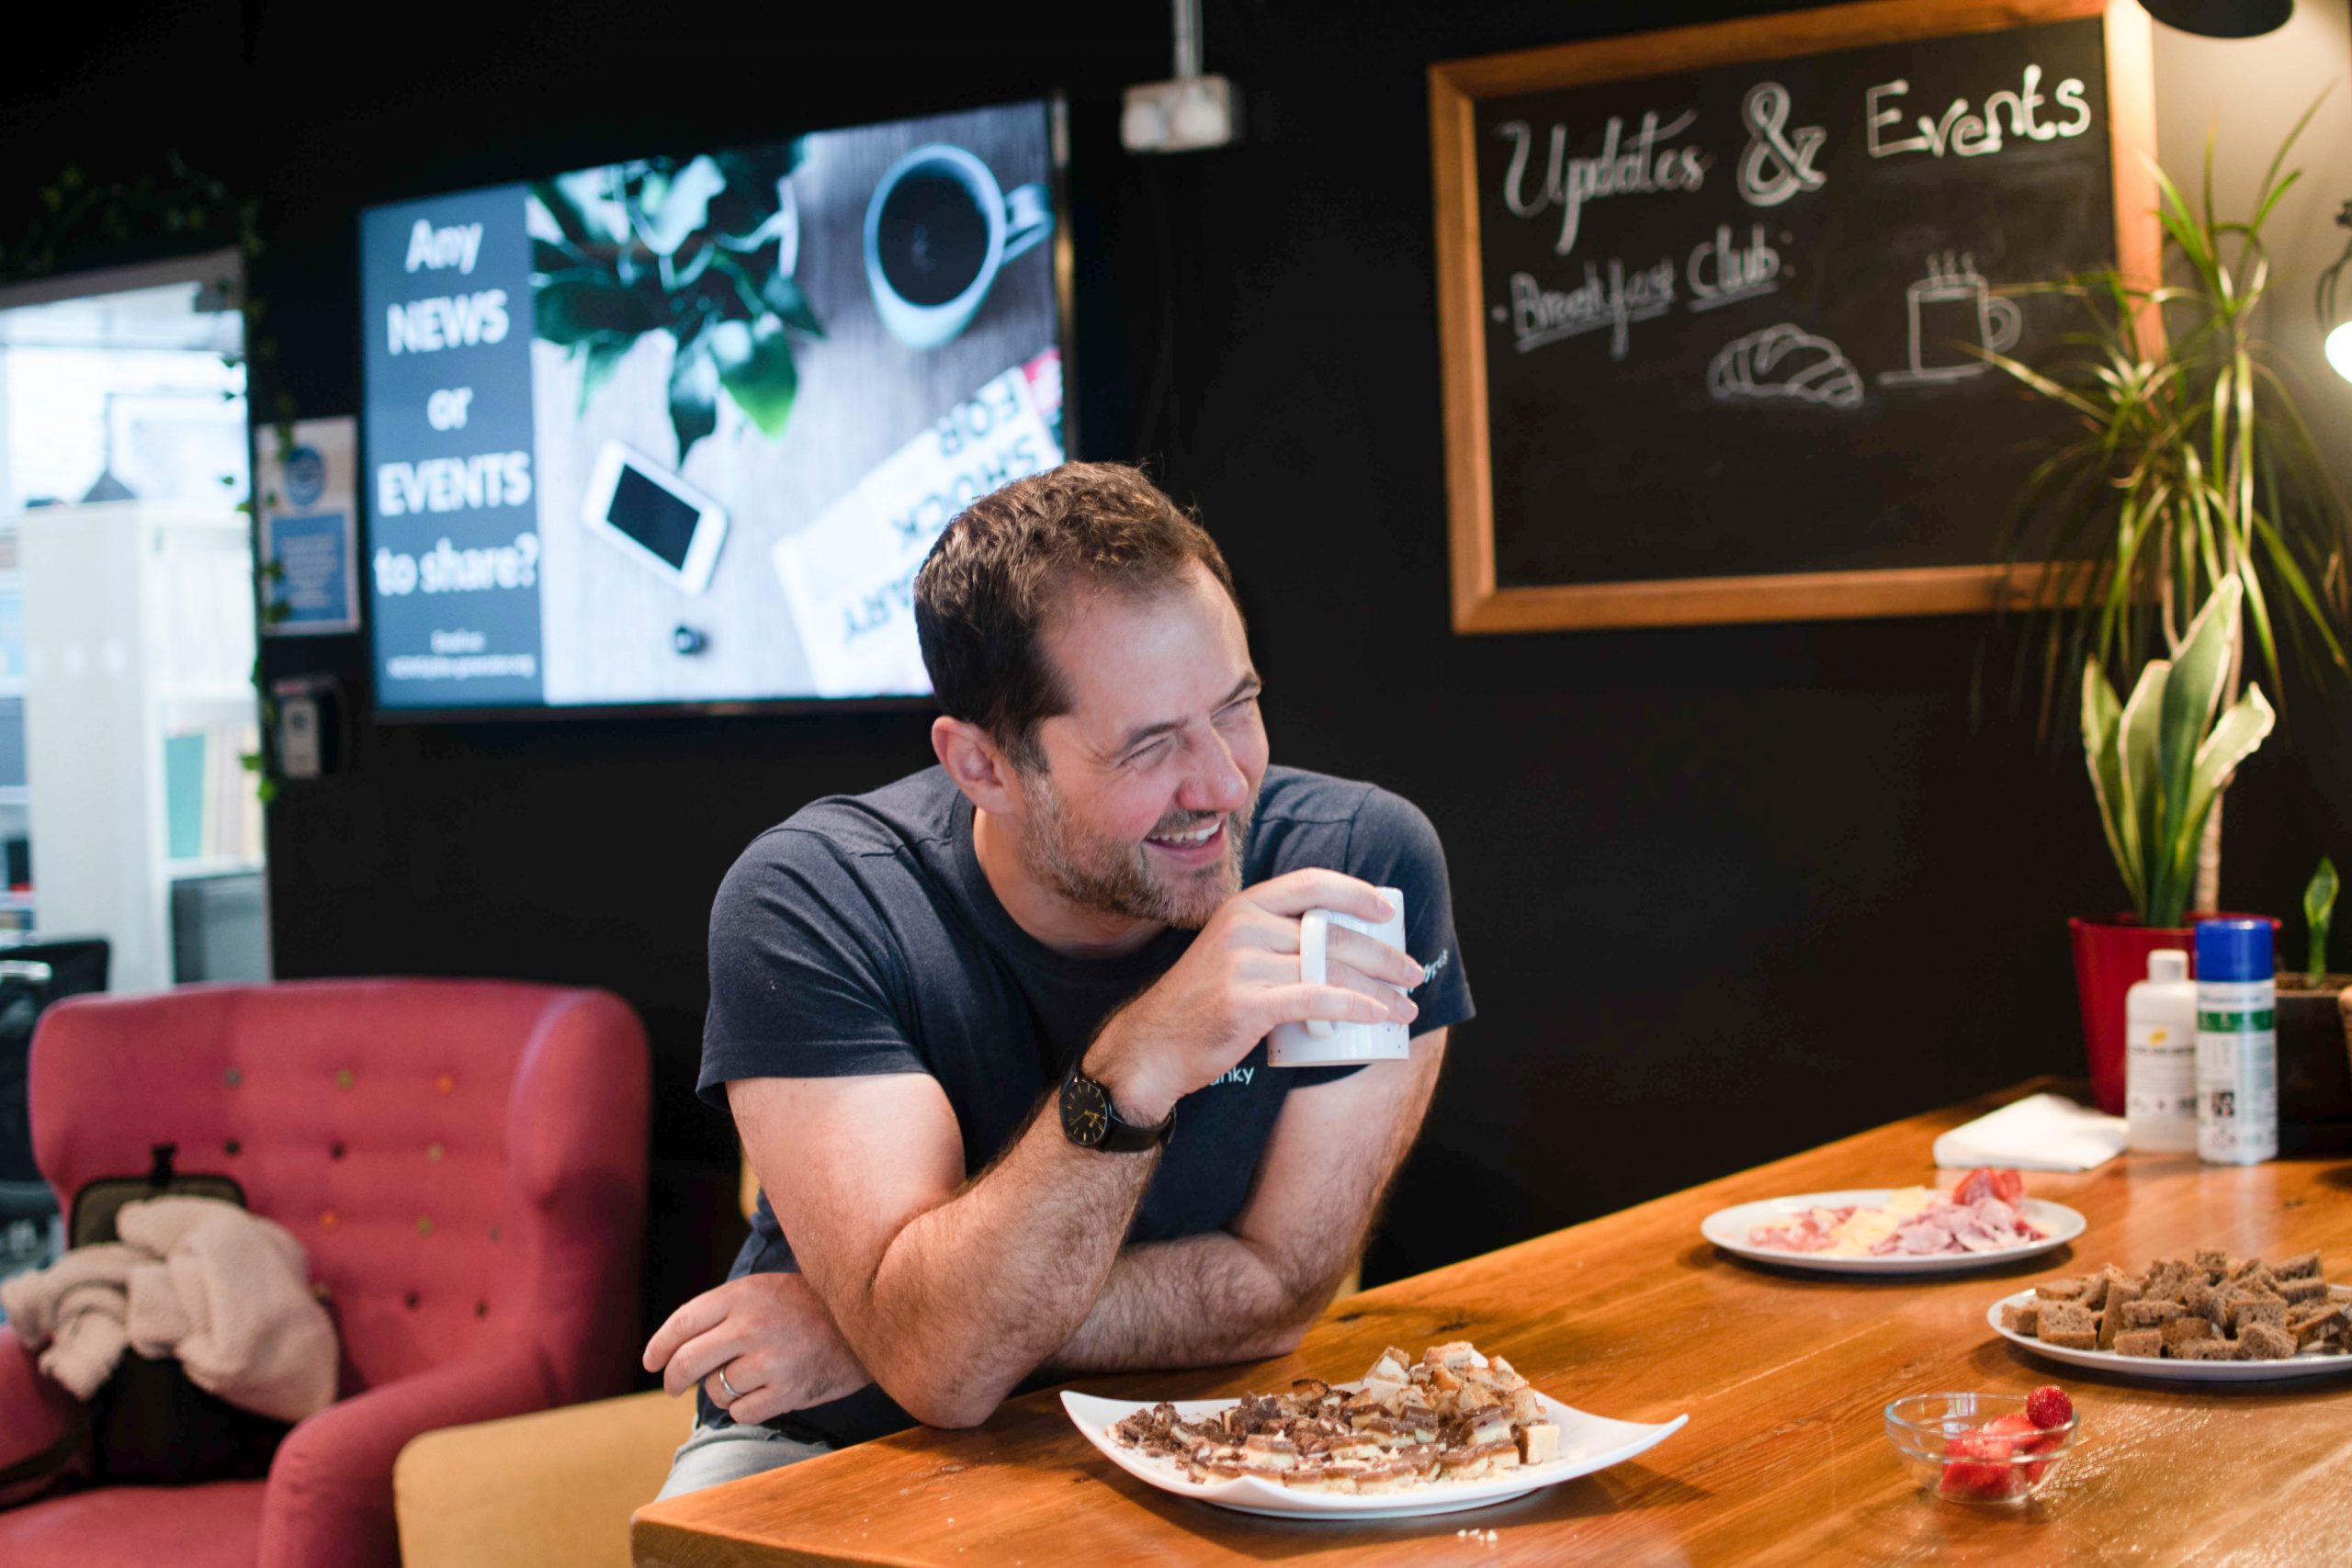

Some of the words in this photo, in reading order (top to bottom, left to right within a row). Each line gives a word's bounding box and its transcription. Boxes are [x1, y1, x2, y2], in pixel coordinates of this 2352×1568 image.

[1497, 109, 1707, 255] Updates
[1737, 82, 1826, 207] &
[1867, 64, 2092, 158] Events
[404, 219, 483, 275] Any
[387, 288, 510, 355] NEWS
[1510, 257, 1675, 361] Breakfast
[426, 386, 474, 432] or
[377, 450, 532, 517] EVENTS
[373, 546, 418, 596] to
[419, 533, 539, 593] share?
